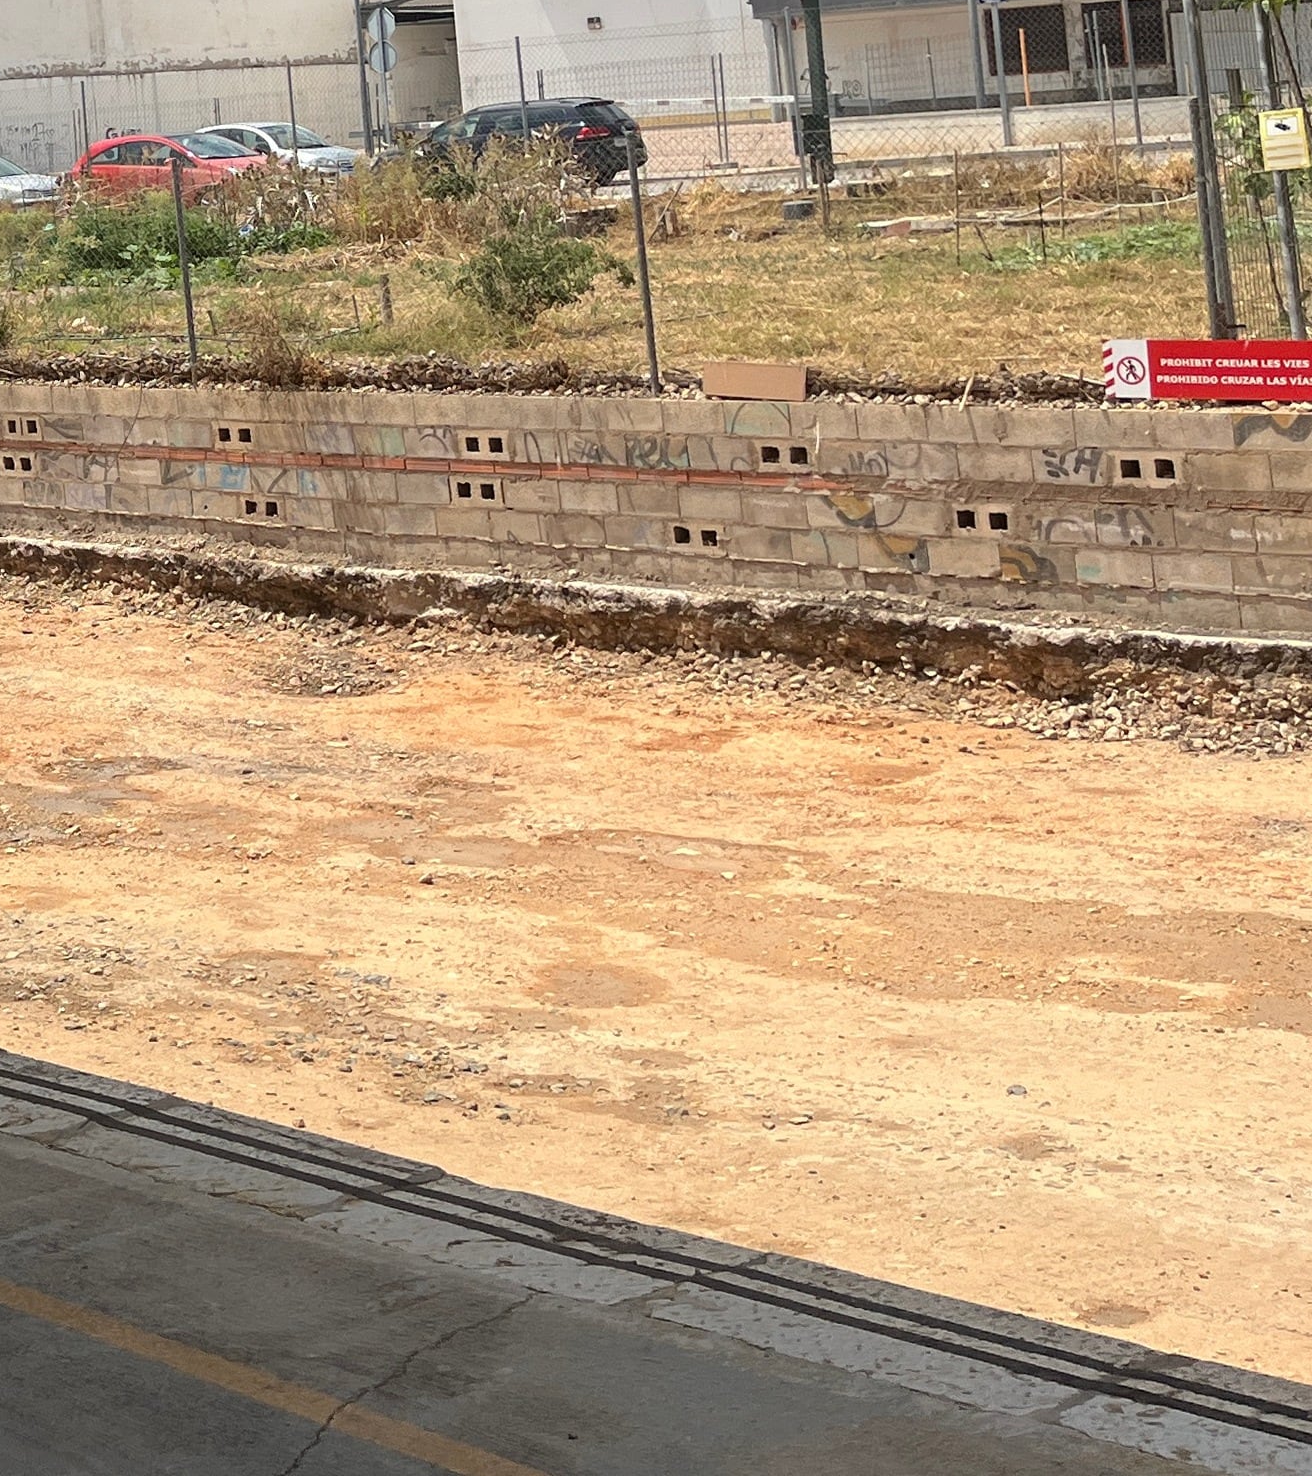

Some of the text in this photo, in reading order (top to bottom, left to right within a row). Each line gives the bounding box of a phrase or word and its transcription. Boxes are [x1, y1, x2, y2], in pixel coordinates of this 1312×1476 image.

[1160, 358, 1310, 369] PROHIBIT CREUAR LES VIES
[1156, 374, 1218, 385] PROHIBIDO
[1221, 375, 1264, 386] CRUZAR
[1266, 376, 1288, 386] LAS
